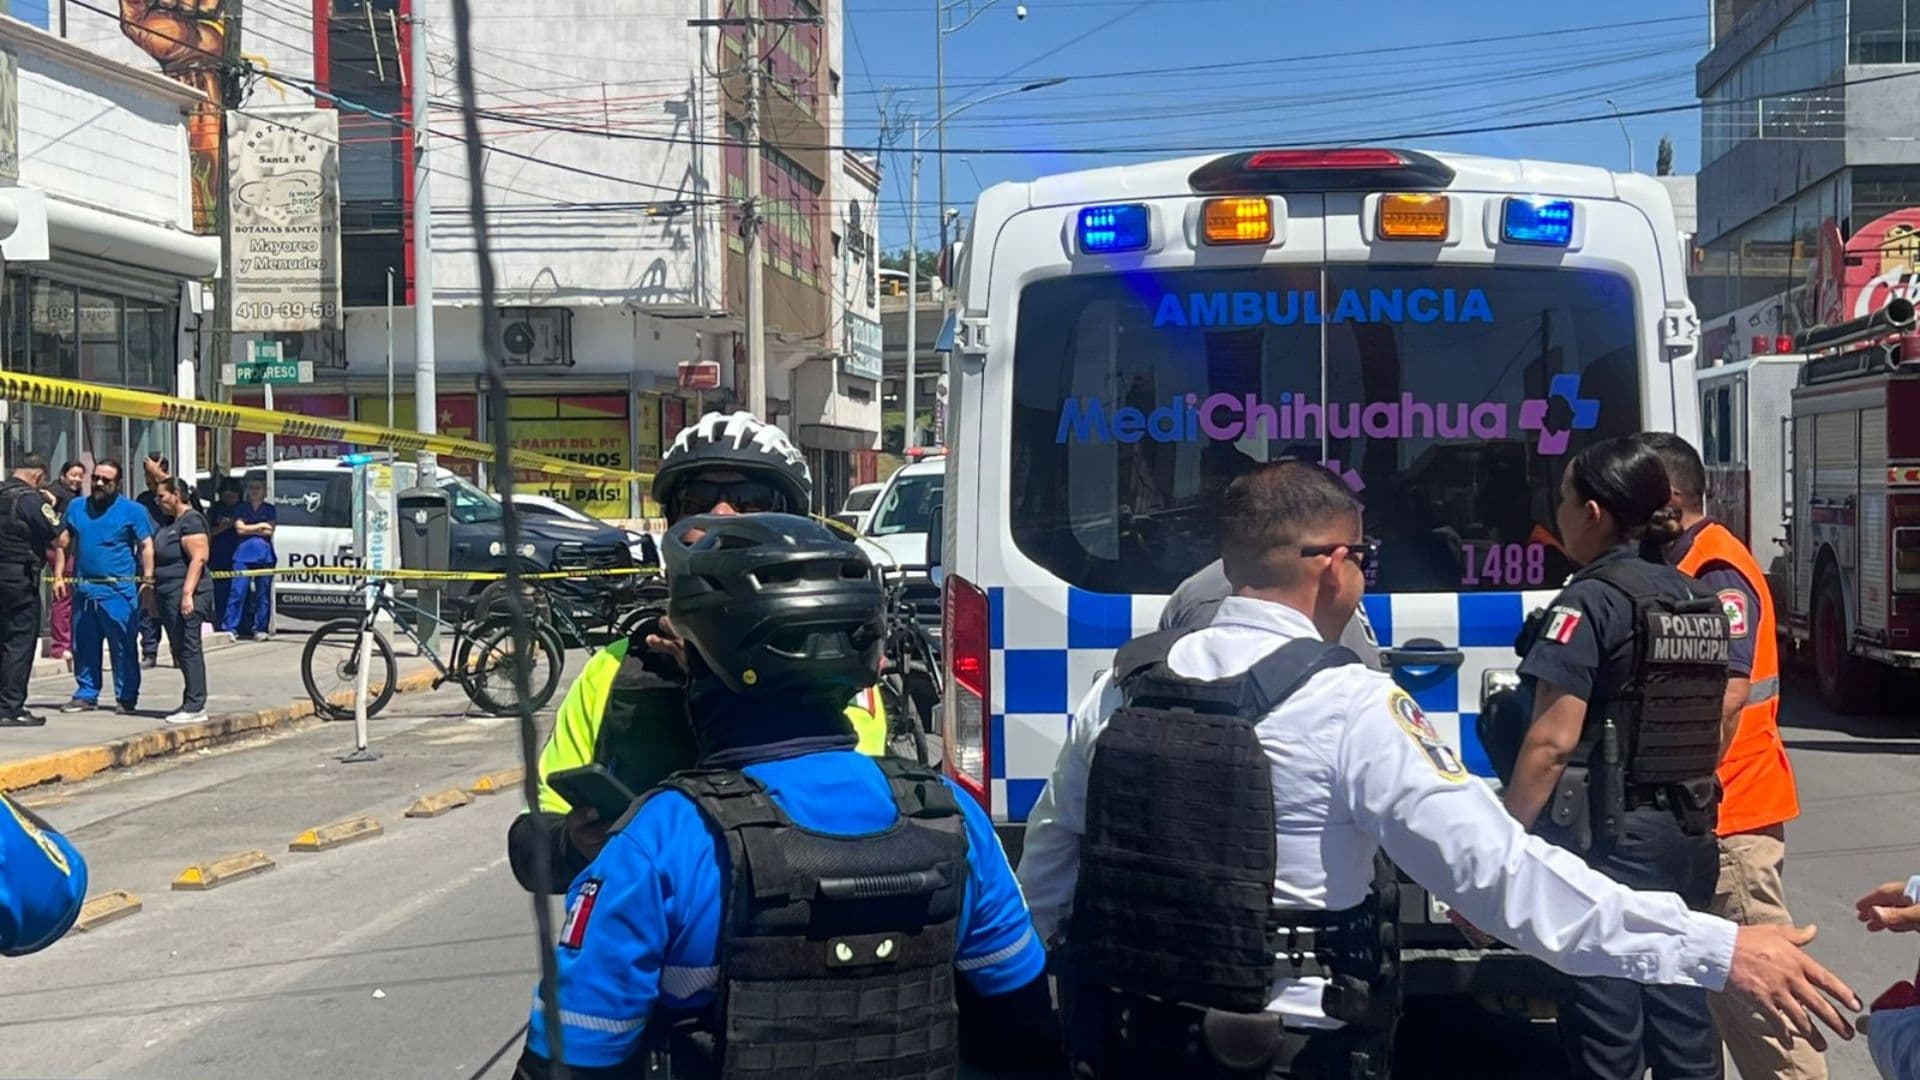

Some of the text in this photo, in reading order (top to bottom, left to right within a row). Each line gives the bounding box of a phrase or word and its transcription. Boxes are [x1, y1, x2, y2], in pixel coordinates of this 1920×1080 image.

[247, 125, 316, 151] BOTANAS
[259, 155, 289, 164] Santa
[235, 226, 282, 234] BOTANAS
[284, 226, 319, 234] SANTA
[249, 239, 319, 256] Mayoreo
[240, 256, 328, 274] y Menudeo
[234, 301, 337, 320] 410-39-58
[1152, 288, 1495, 328] AMBULANCIA
[1056, 392, 1507, 443] MediChihuahua
[521, 437, 567, 449] PARTE
[571, 437, 597, 449] DEL
[539, 485, 621, 502] DEL PAÍS!
[1461, 543, 1545, 585] 1488
[282, 593, 346, 605] CHIHUAHUA
[1659, 615, 1723, 638] POLICIA
